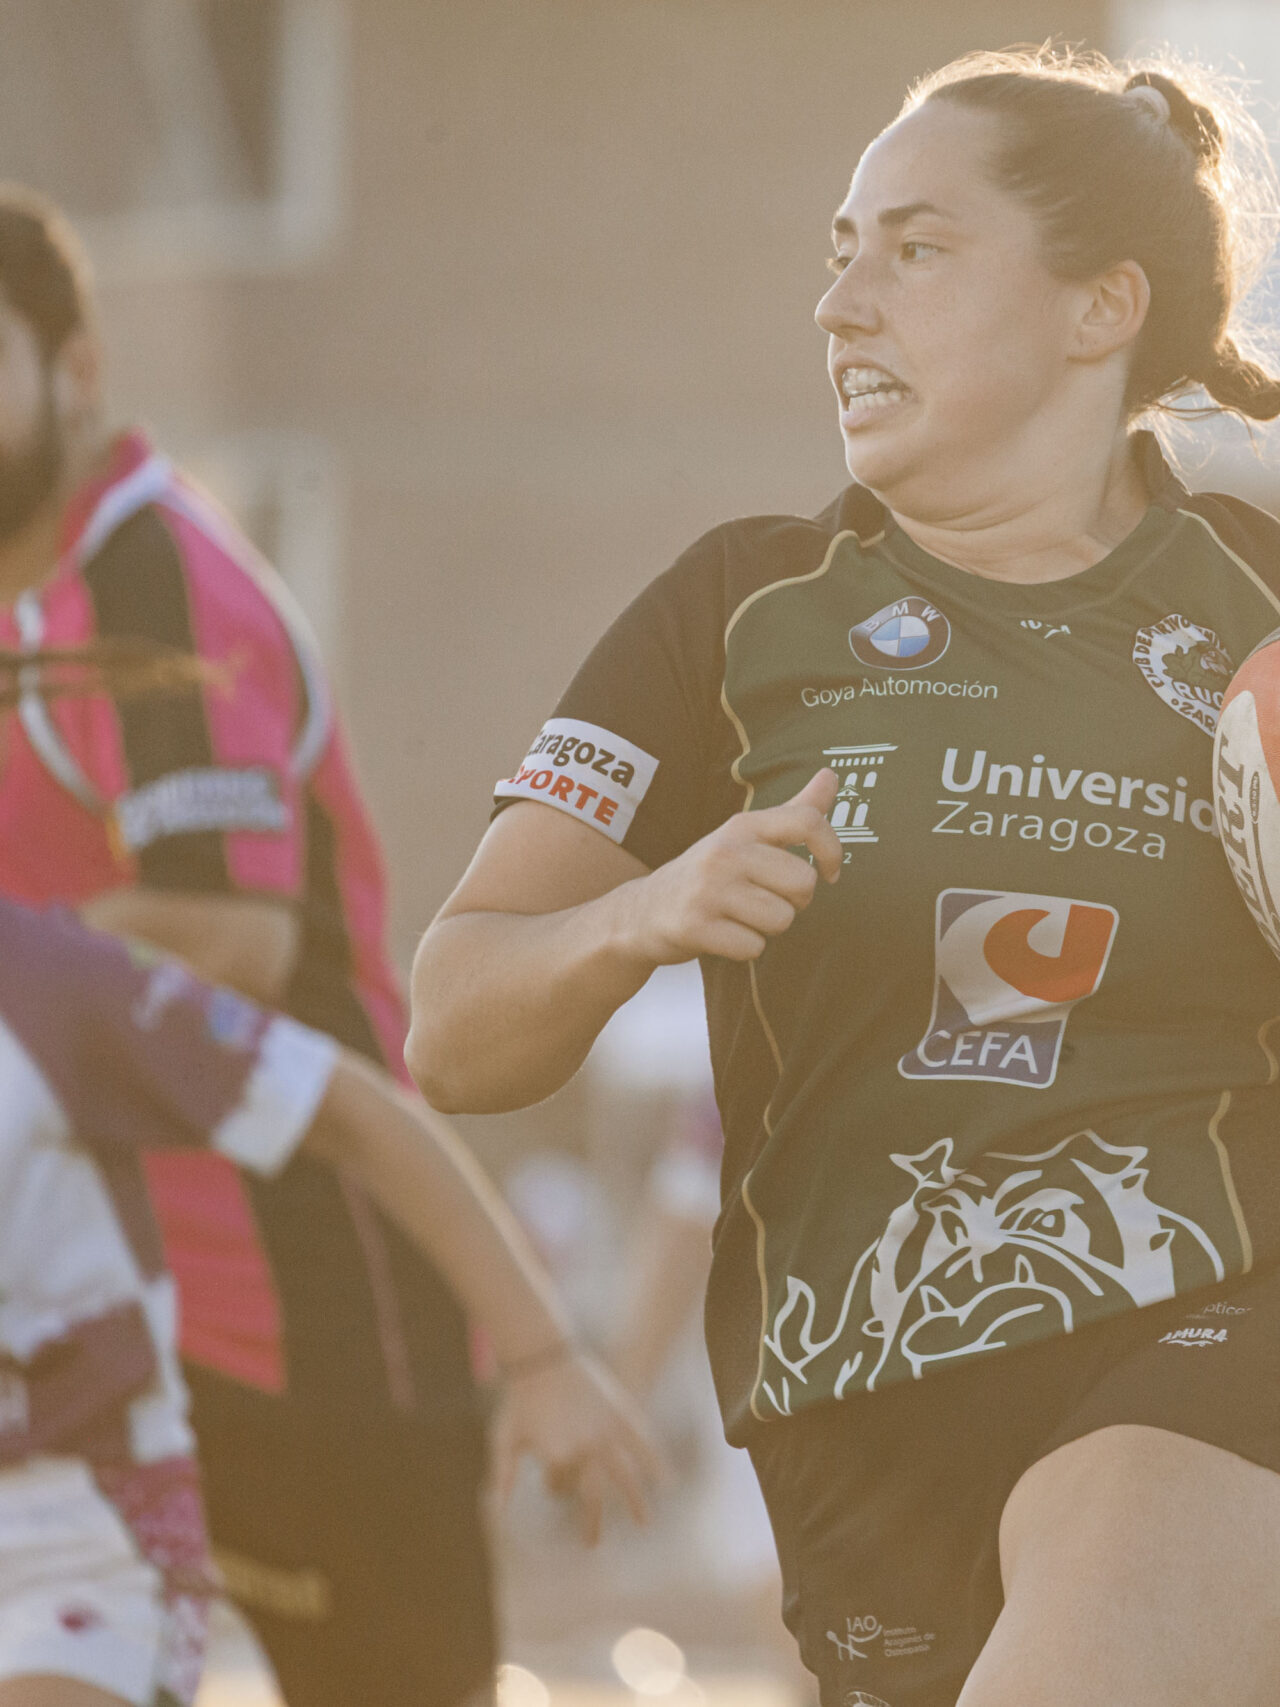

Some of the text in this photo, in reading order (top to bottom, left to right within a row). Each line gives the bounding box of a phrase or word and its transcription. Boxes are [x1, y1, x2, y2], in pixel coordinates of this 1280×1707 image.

[801, 676, 998, 707] Goya Automoción
[530, 731, 635, 789] aragoza
[932, 800, 1166, 860] Zaragoza
[916, 1030, 1038, 1074] CEFA
